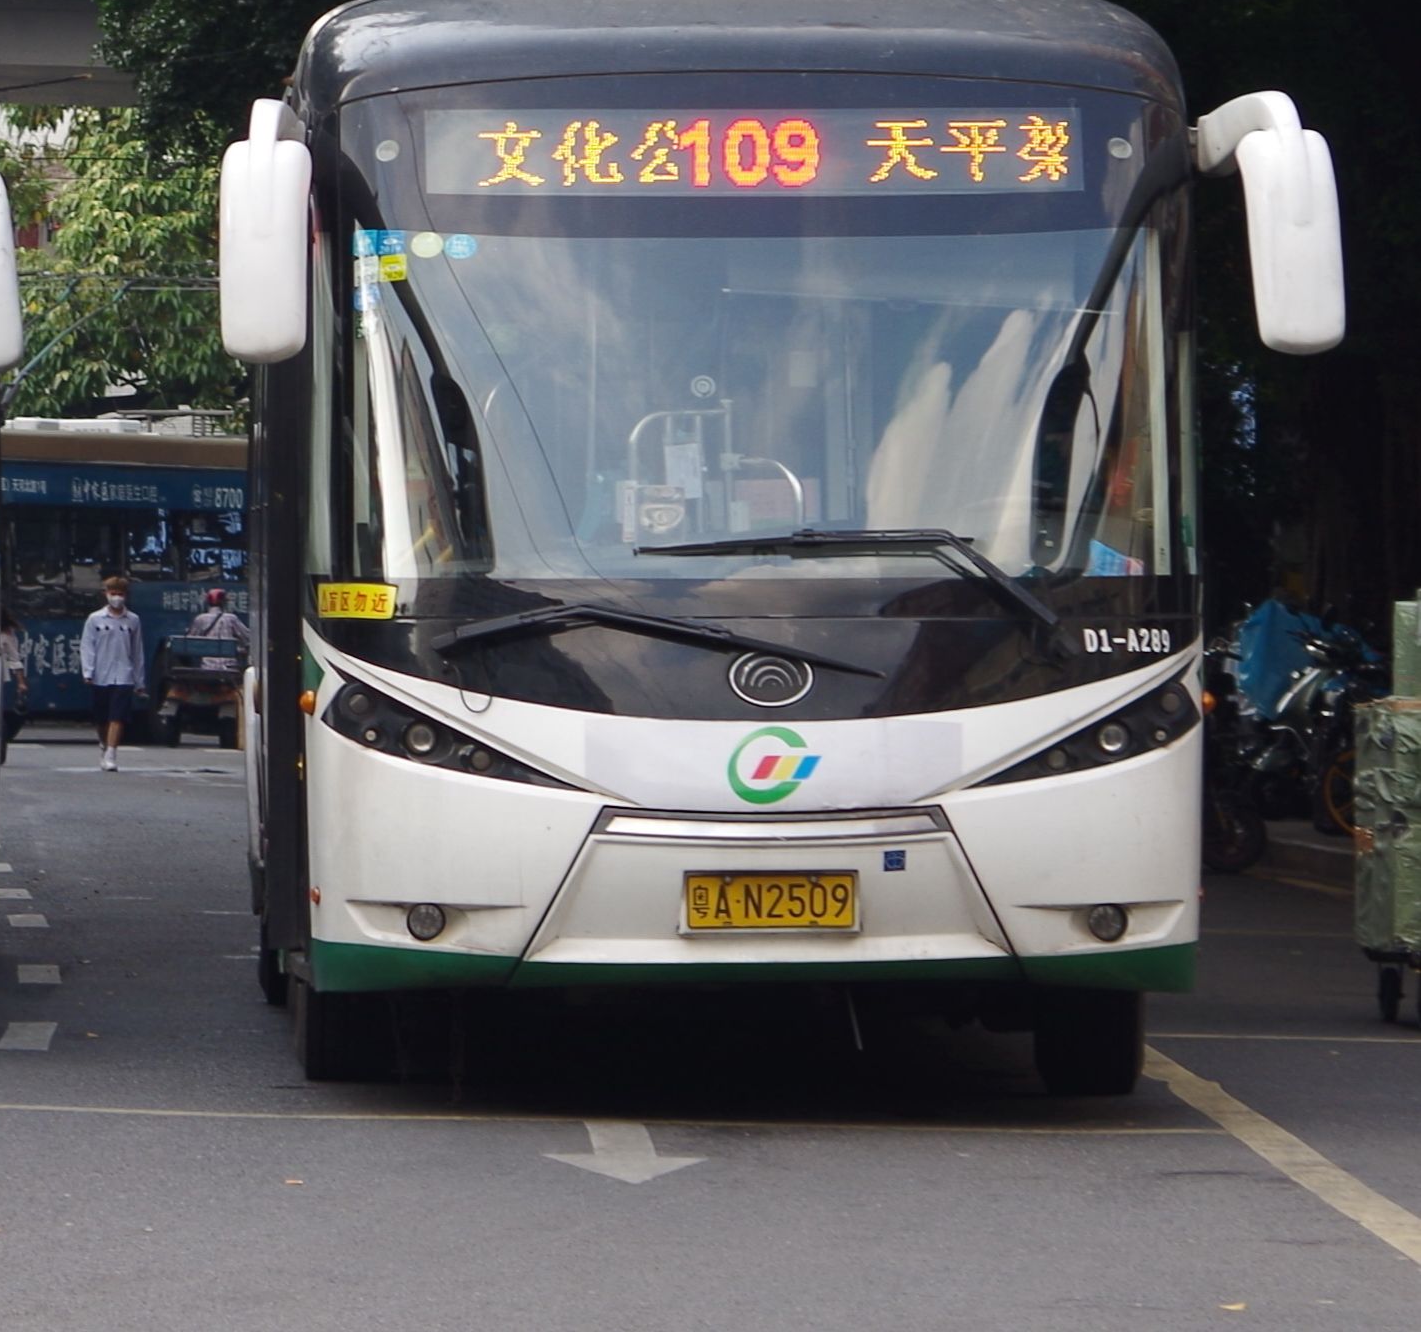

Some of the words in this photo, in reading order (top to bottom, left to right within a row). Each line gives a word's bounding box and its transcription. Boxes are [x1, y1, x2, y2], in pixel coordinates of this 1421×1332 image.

[678, 119, 820, 187] 109
[866, 115, 1069, 182] 天平架
[215, 488, 243, 508] 8700
[329, 590, 388, 613] 盲区勿近
[1083, 628, 1170, 653] D1-A289
